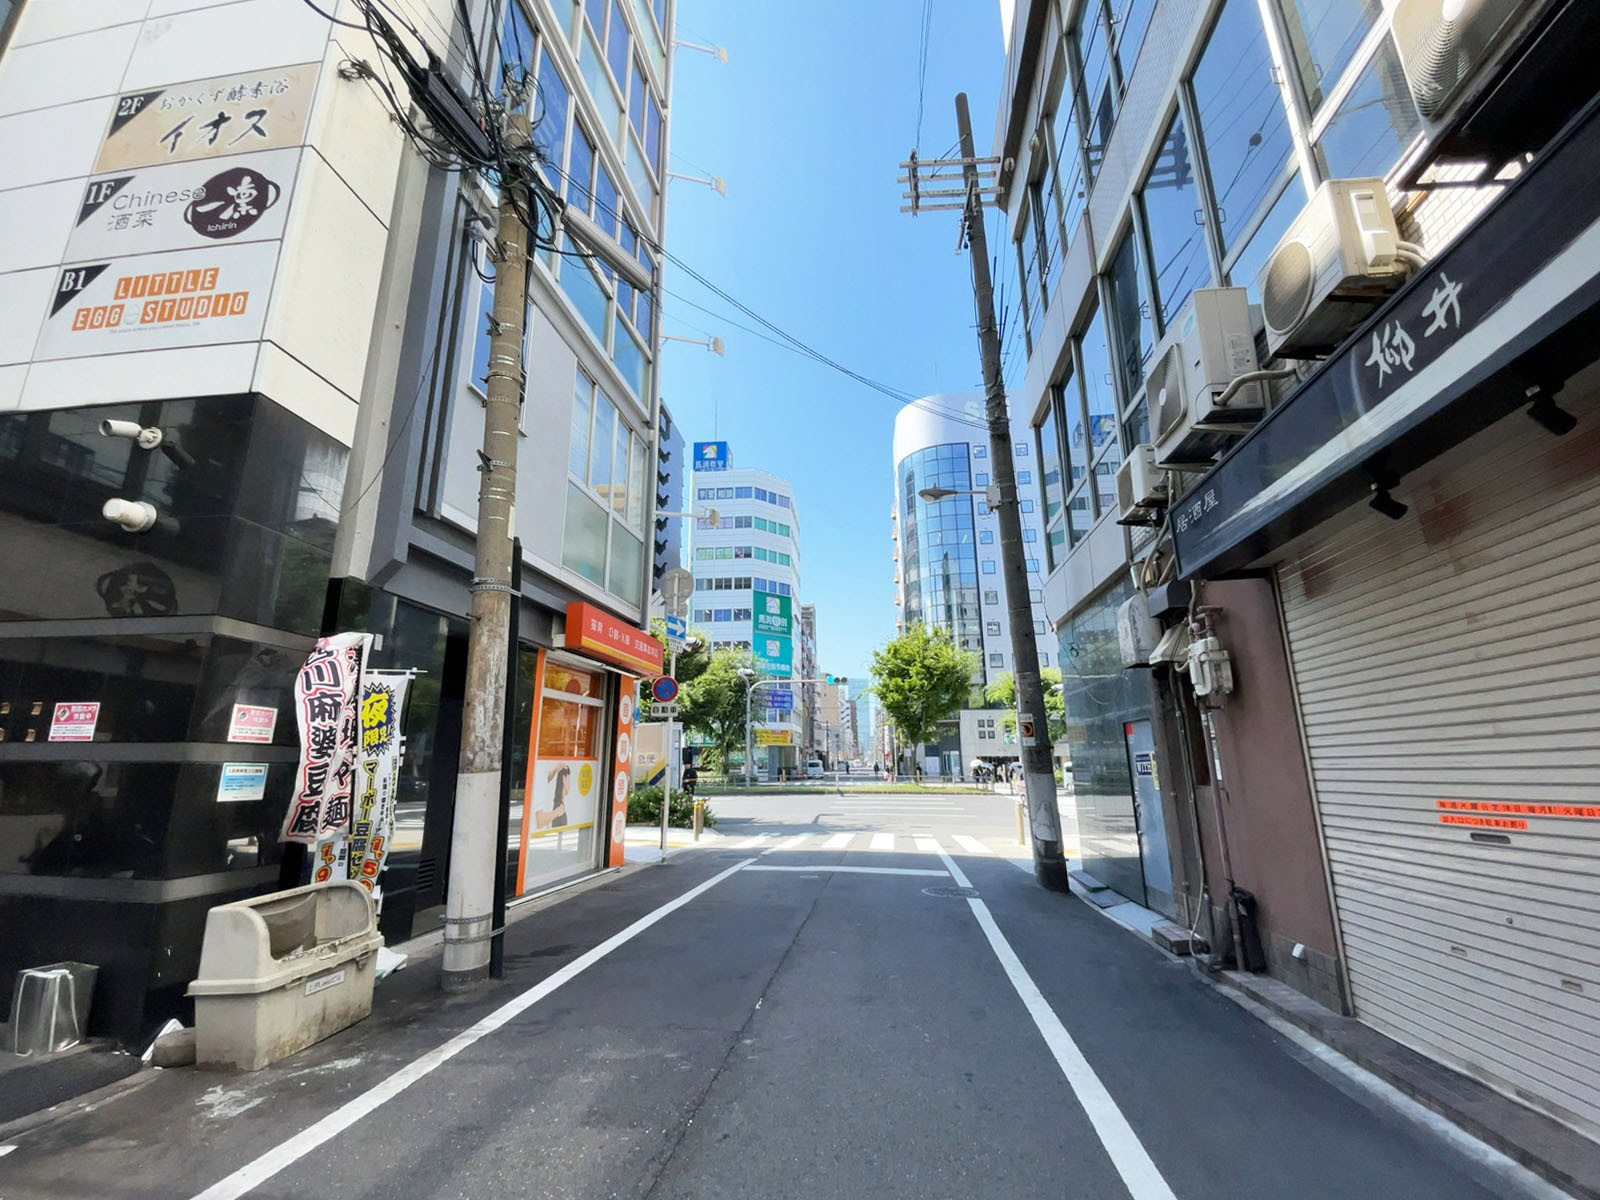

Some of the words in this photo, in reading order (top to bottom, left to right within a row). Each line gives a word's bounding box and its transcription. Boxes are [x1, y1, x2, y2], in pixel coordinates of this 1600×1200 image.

[118, 97, 145, 117] 2F
[160, 108, 268, 154] イオス
[85, 180, 117, 206] 1F
[112, 186, 206, 211] Chinese
[107, 209, 158, 232] 酒菜
[60, 270, 87, 293] B1
[115, 268, 219, 300] LITTLE
[73, 305, 124, 331] EGG
[141, 292, 248, 323] STUDIO
[1176, 488, 1219, 533] 居酒屋
[361, 692, 389, 729] 夜
